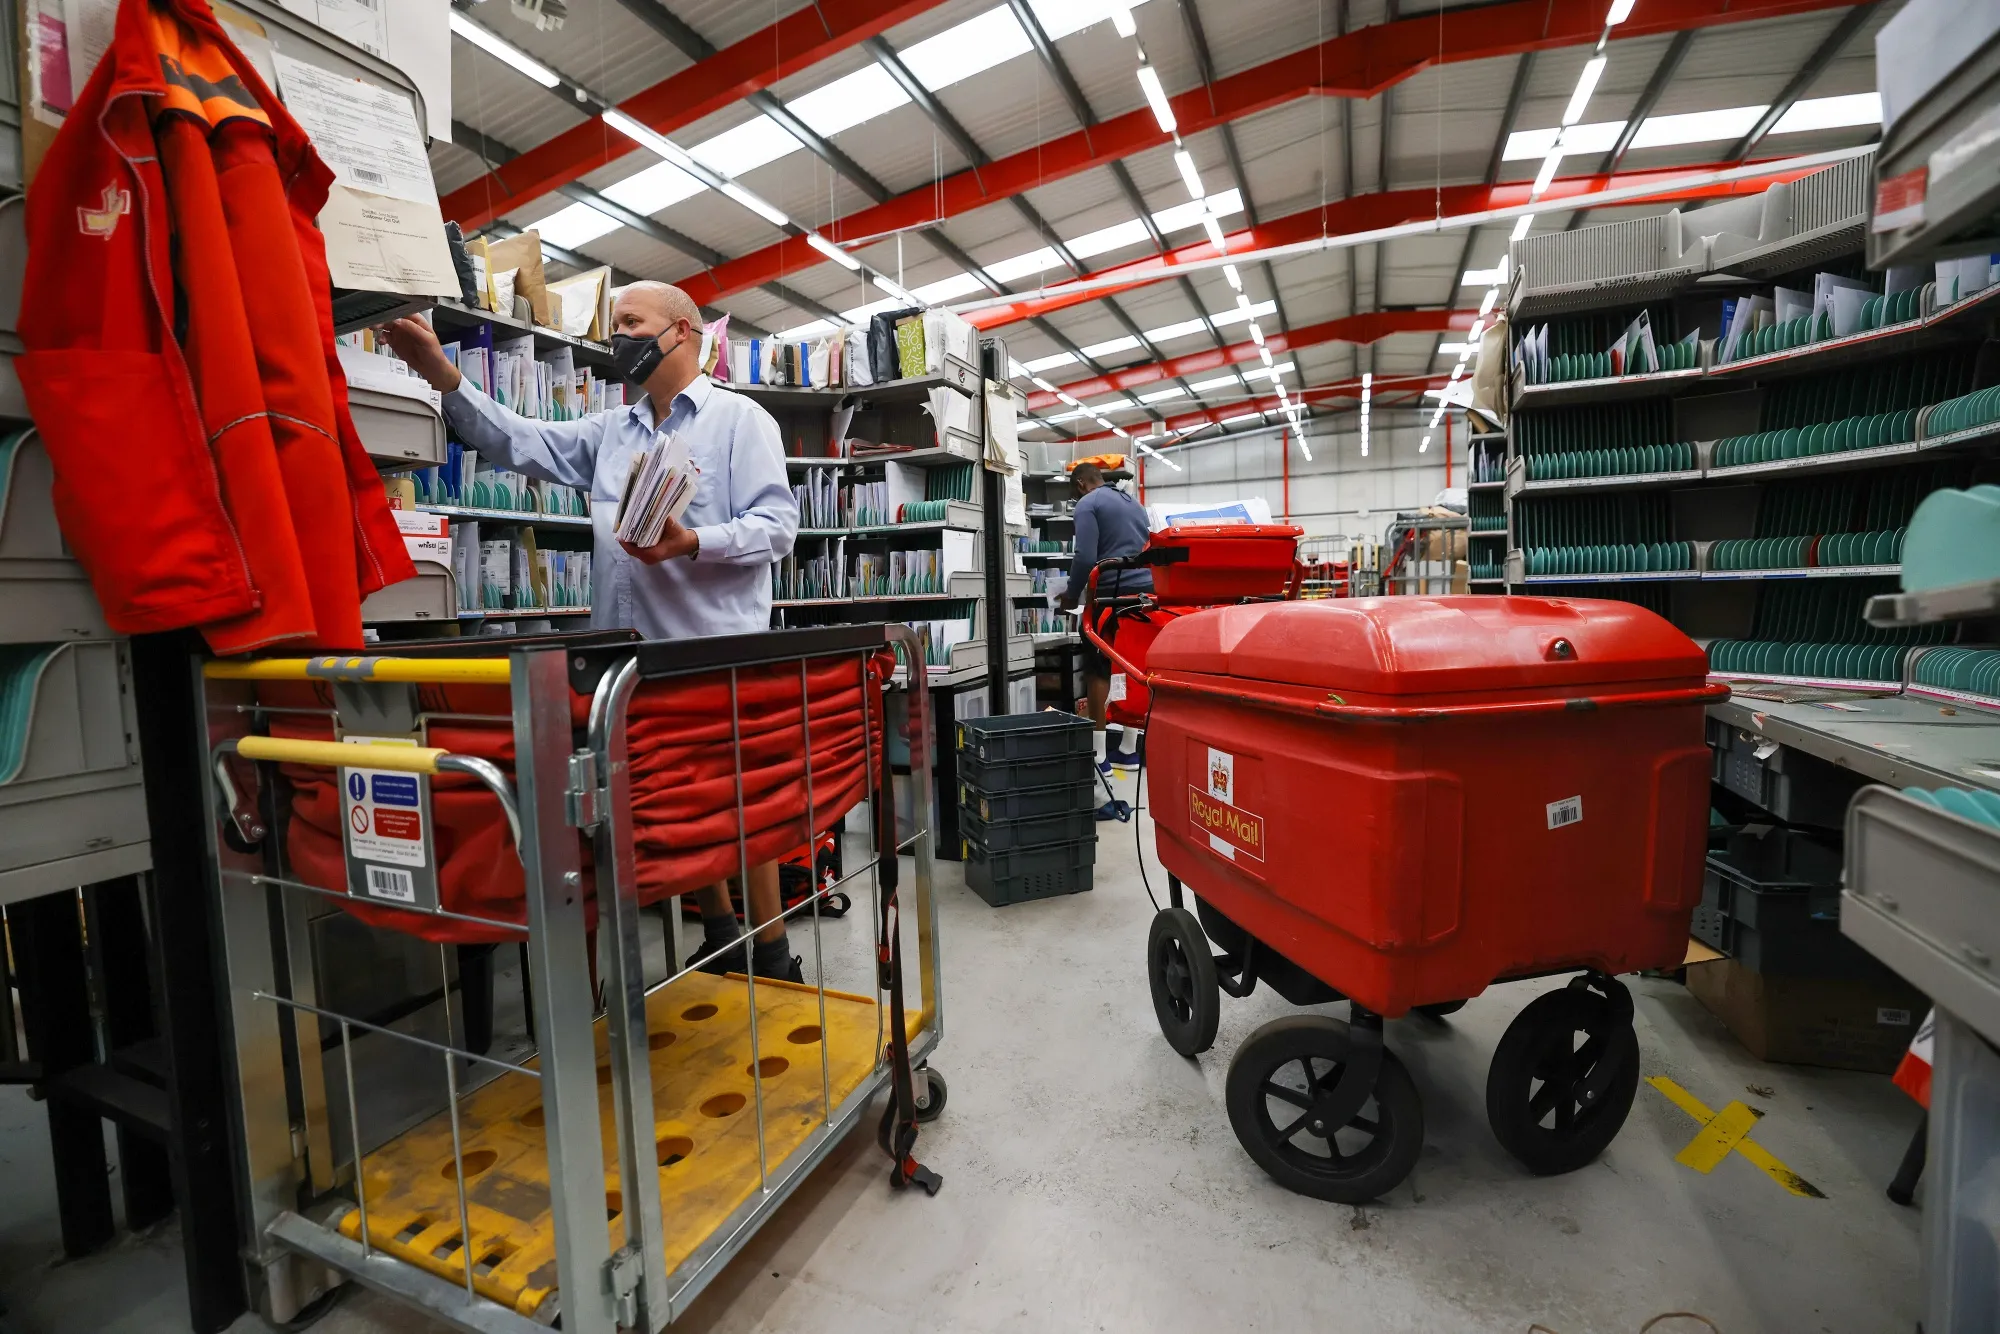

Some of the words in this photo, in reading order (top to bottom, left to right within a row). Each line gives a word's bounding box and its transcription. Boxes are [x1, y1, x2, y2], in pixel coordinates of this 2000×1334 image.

[418, 541, 437, 549] whistl
[1192, 793, 1223, 827] Royal
[1226, 811, 1258, 846] Mail
